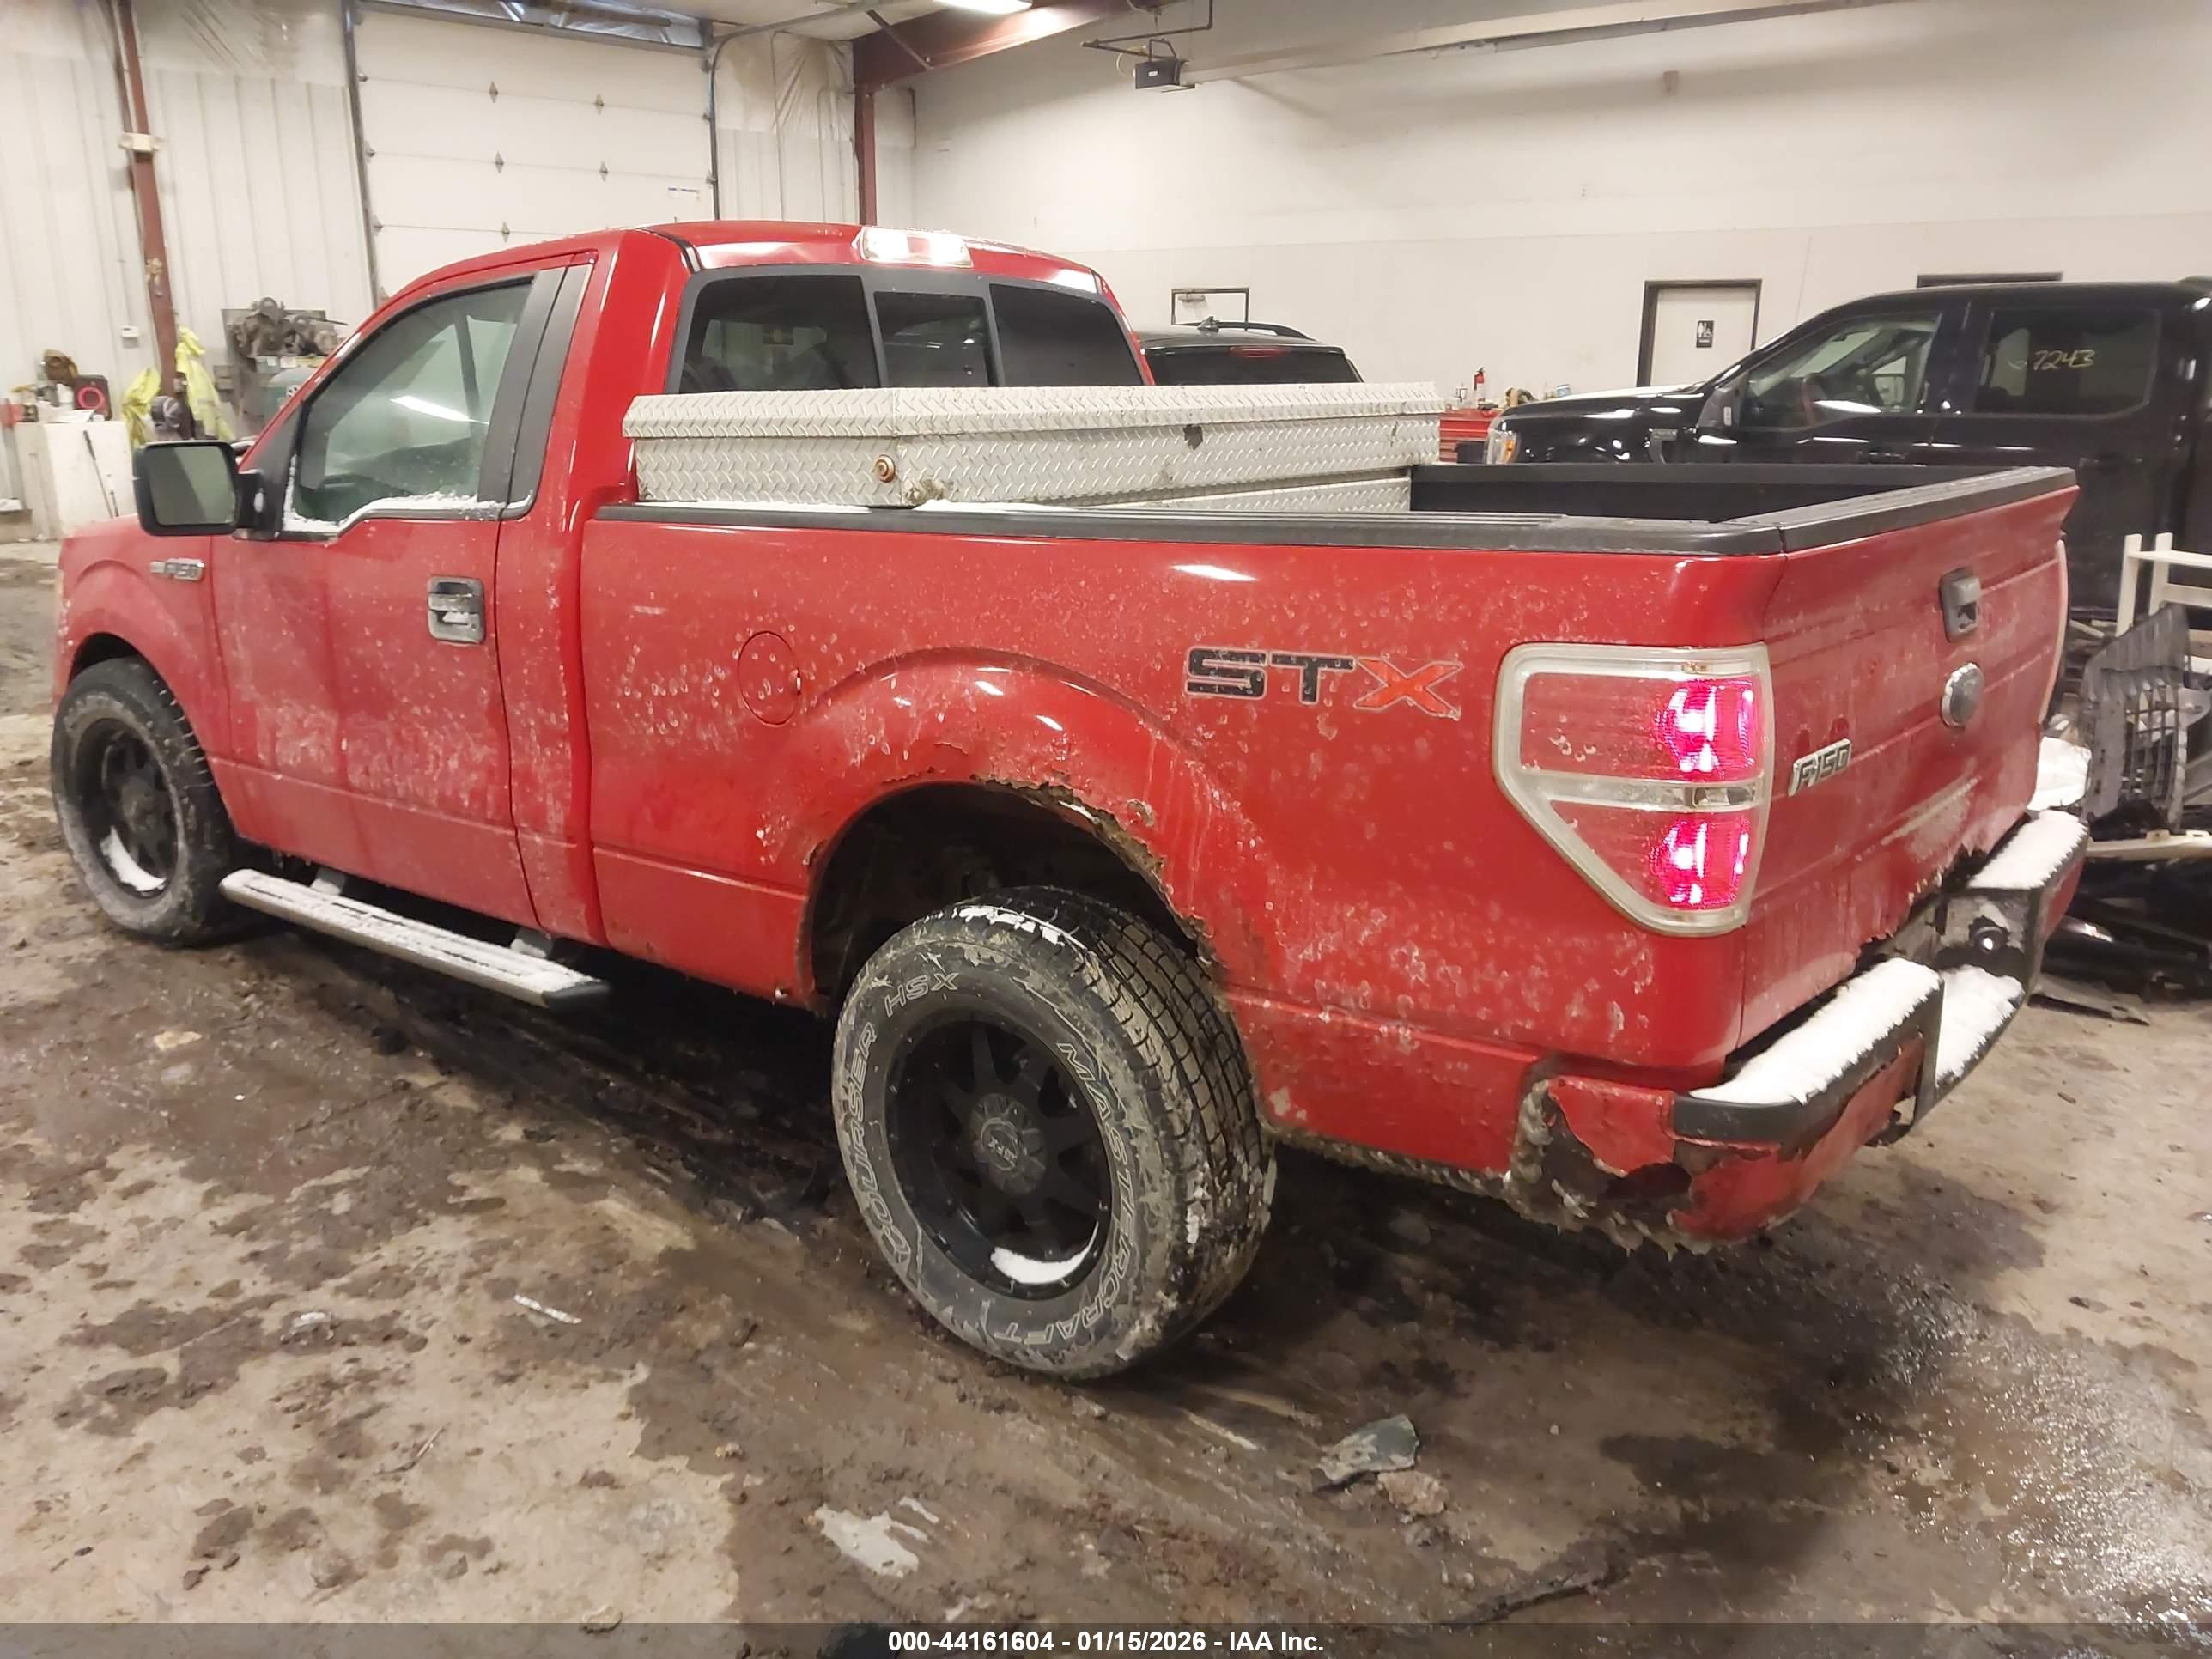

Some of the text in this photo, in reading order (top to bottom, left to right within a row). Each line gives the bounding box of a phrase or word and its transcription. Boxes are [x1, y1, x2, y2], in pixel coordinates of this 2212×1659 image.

[1185, 647, 1463, 721] STX
[850, 972, 959, 1265] COURSER HSX
[993, 1042, 1136, 1345] MASTERCRAFT
